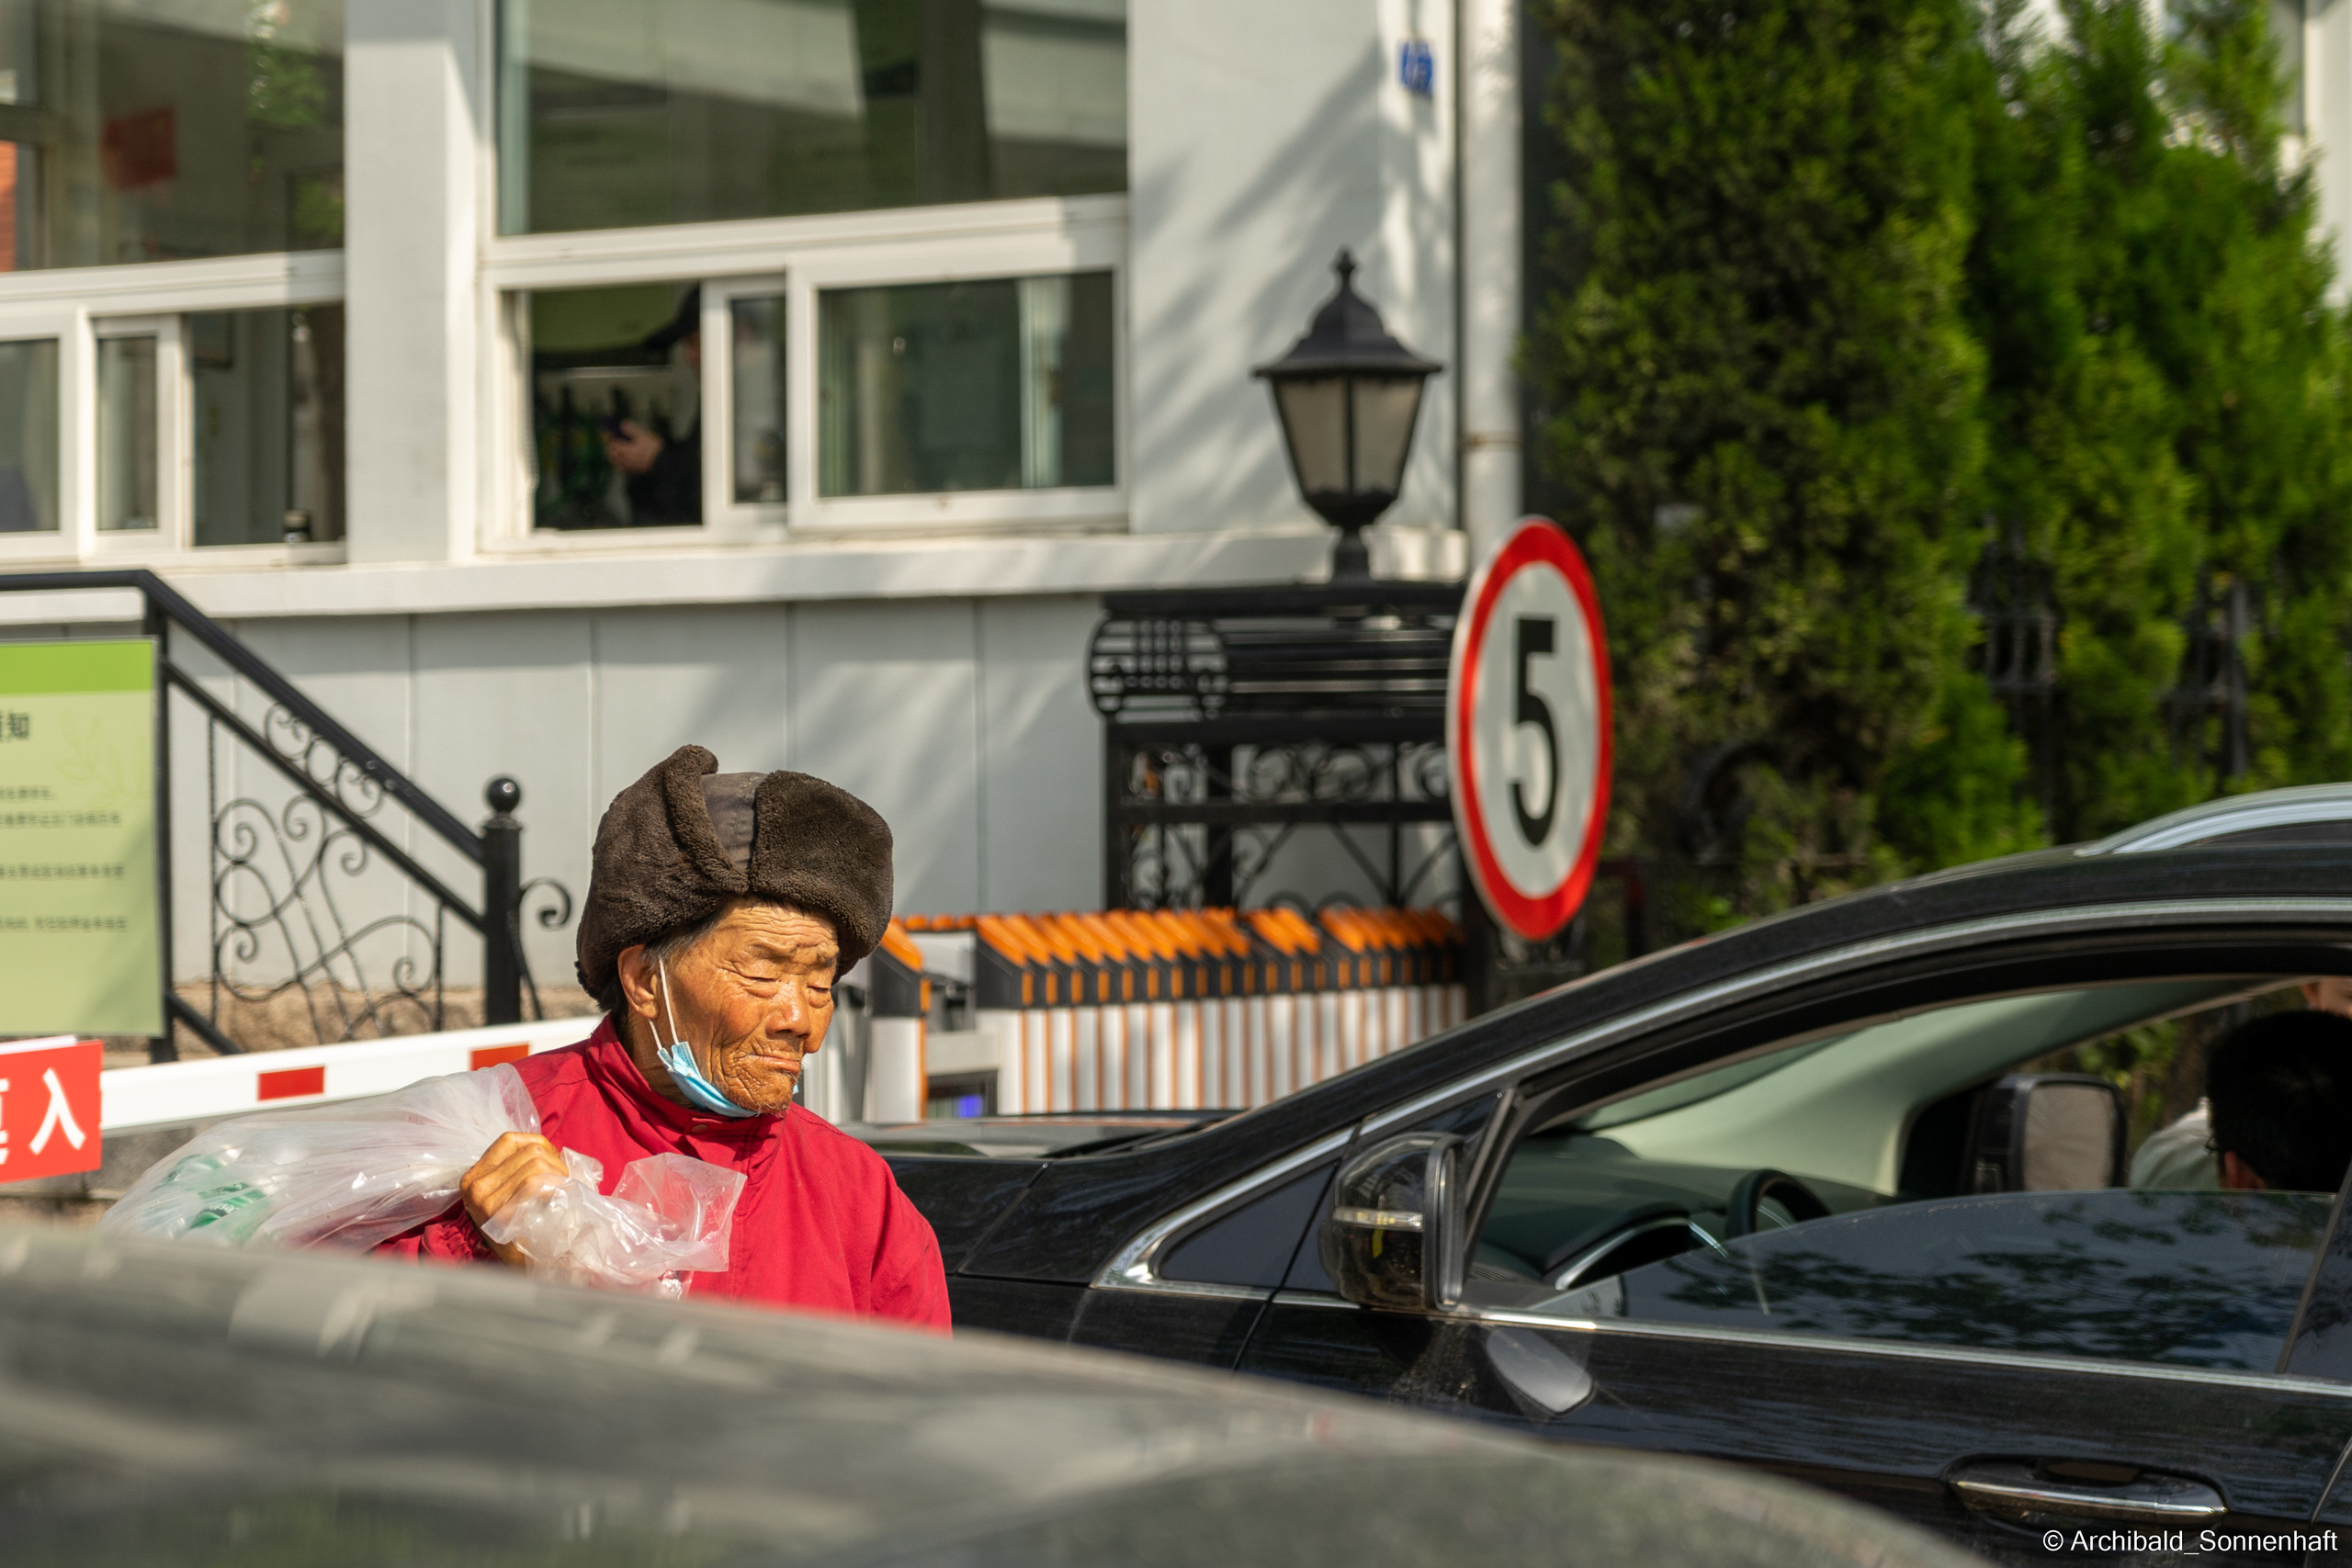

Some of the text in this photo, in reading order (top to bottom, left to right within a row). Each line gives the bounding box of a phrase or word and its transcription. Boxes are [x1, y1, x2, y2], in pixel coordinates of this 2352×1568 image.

[0, 711, 30, 742] 知
[1510, 616, 1560, 849] 5
[0, 1067, 86, 1165] 入
